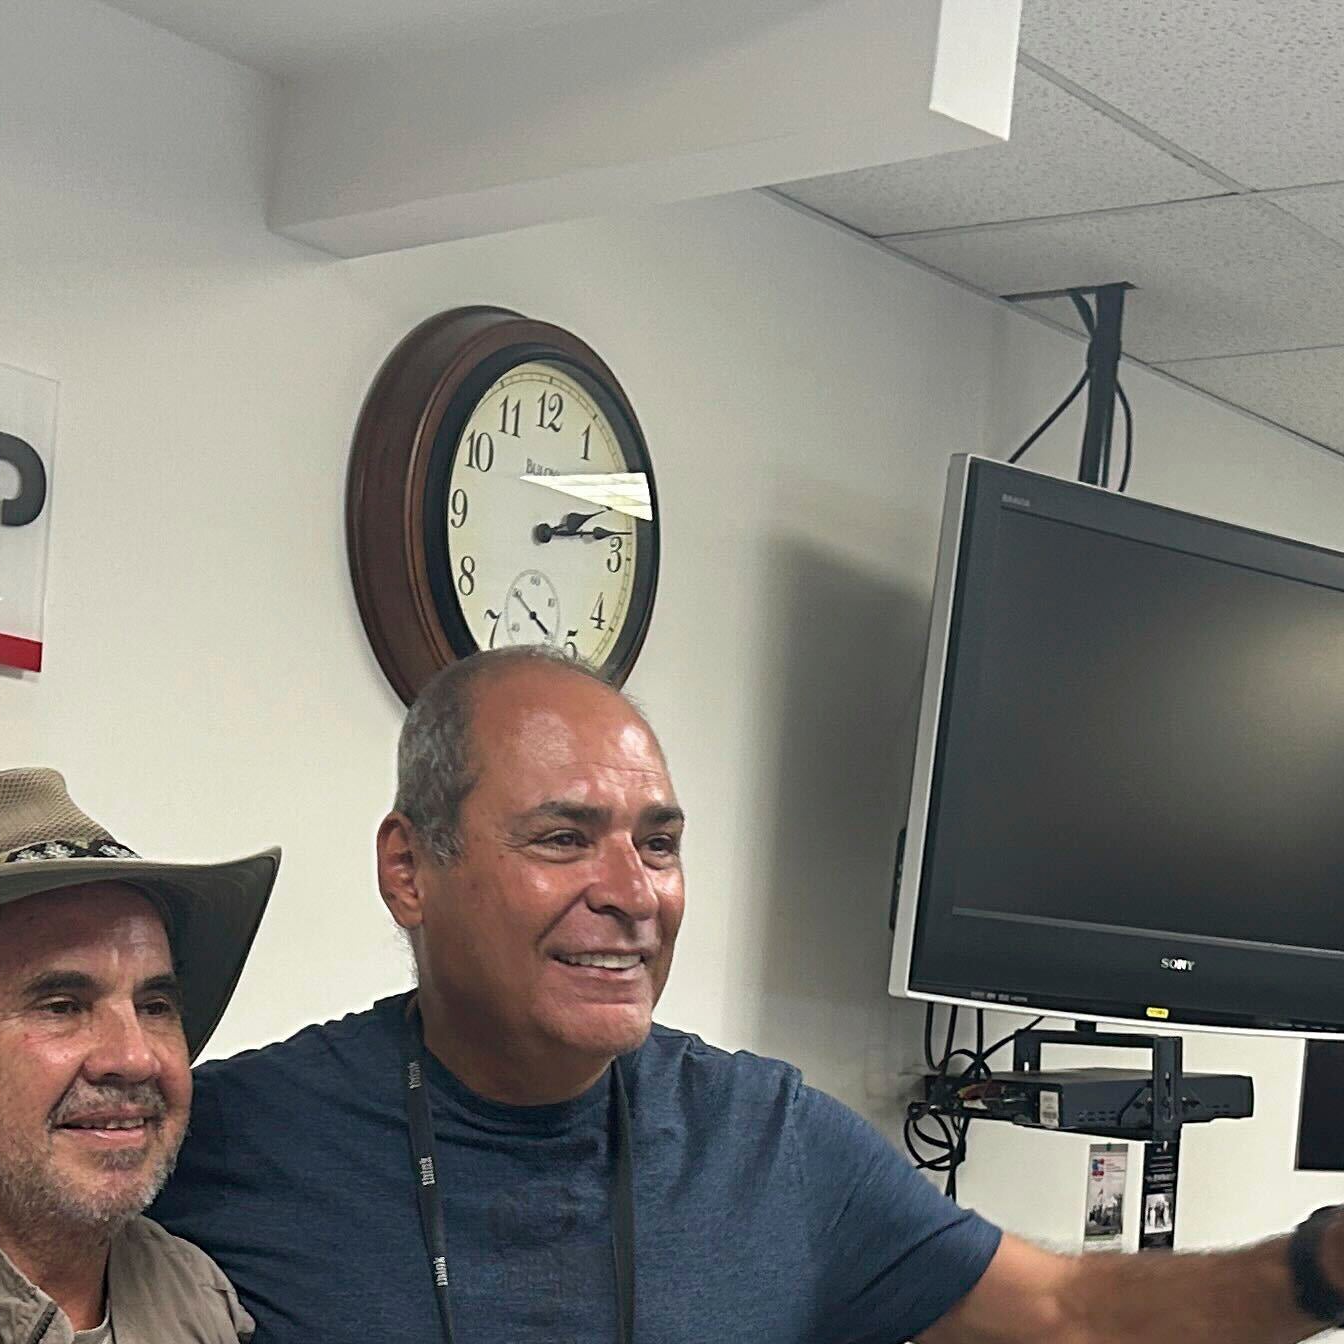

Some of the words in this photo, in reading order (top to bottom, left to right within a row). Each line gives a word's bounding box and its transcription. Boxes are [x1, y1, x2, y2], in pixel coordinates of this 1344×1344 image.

[498, 394, 522, 438] 11
[536, 389, 565, 433] 12
[465, 428, 494, 473] 10
[580, 423, 592, 461] 1
[526, 458, 561, 477] BULO
[450, 488, 468, 529] 9
[606, 536, 624, 573] 3
[457, 555, 476, 597] 8
[484, 609, 503, 650] 7
[589, 591, 607, 631] 4
[562, 629, 579, 662] 5
[1160, 957, 1195, 971] SONY
[418, 1155, 436, 1186] think
[432, 1256, 449, 1287] think
